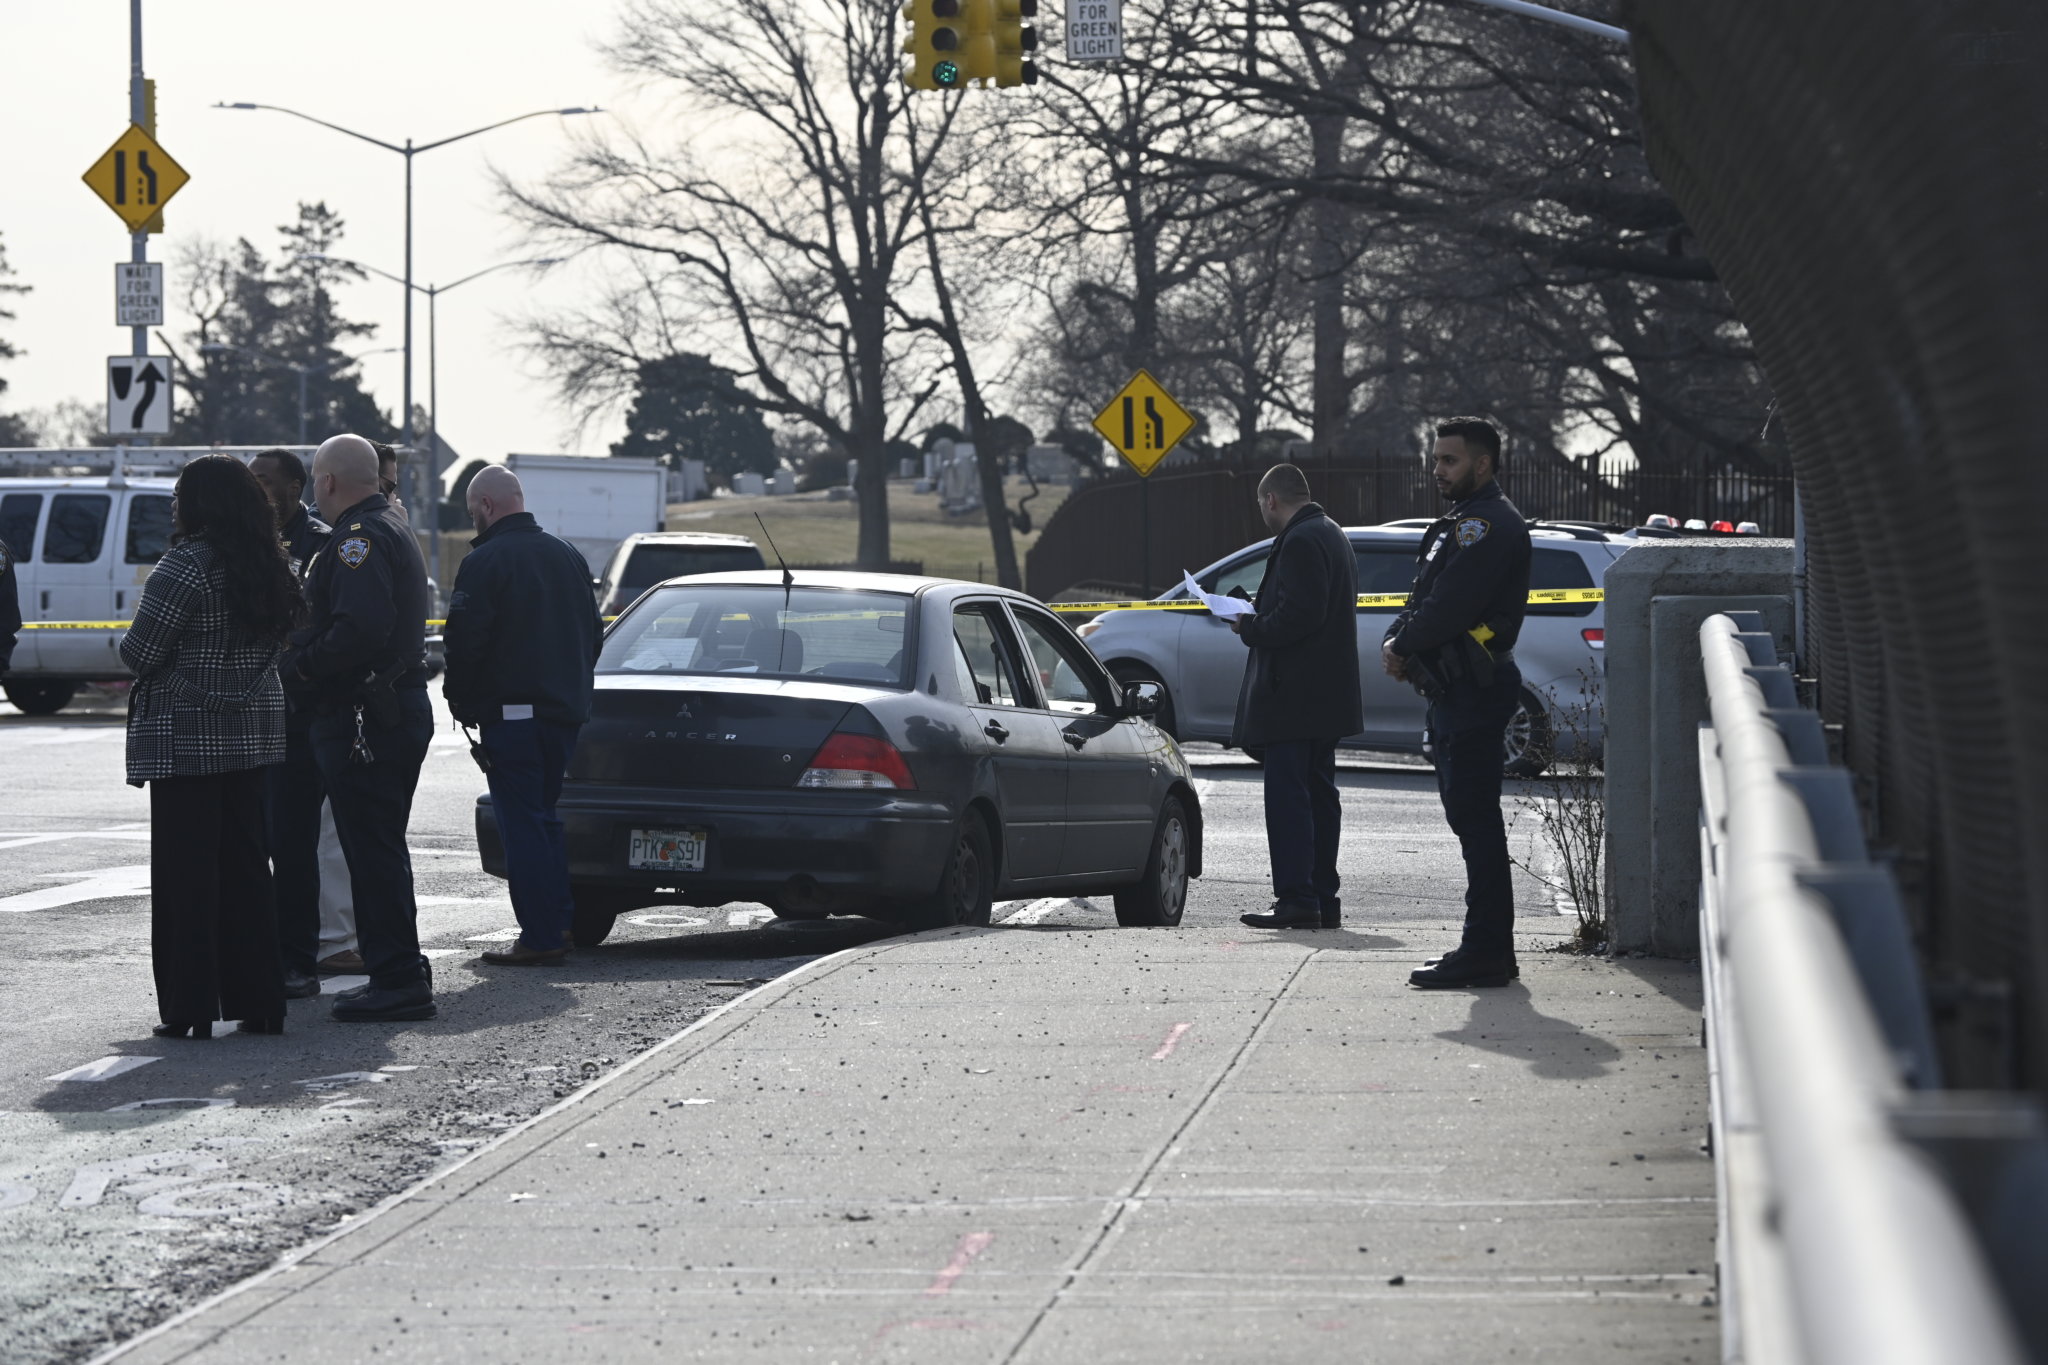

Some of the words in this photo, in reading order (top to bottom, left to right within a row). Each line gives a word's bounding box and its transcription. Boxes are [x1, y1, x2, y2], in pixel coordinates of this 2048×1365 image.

[1079, 4, 1107, 19] FOR
[1071, 22, 1117, 37] GREEN
[1074, 39, 1114, 54] LIGHT
[125, 266, 152, 278] WAIT
[127, 280, 151, 293] FOR
[120, 294, 159, 307] GREEN
[121, 309, 156, 322] LIGHT
[627, 730, 737, 741] ANCER
[632, 838, 659, 860] PTK
[677, 840, 701, 861] S91
